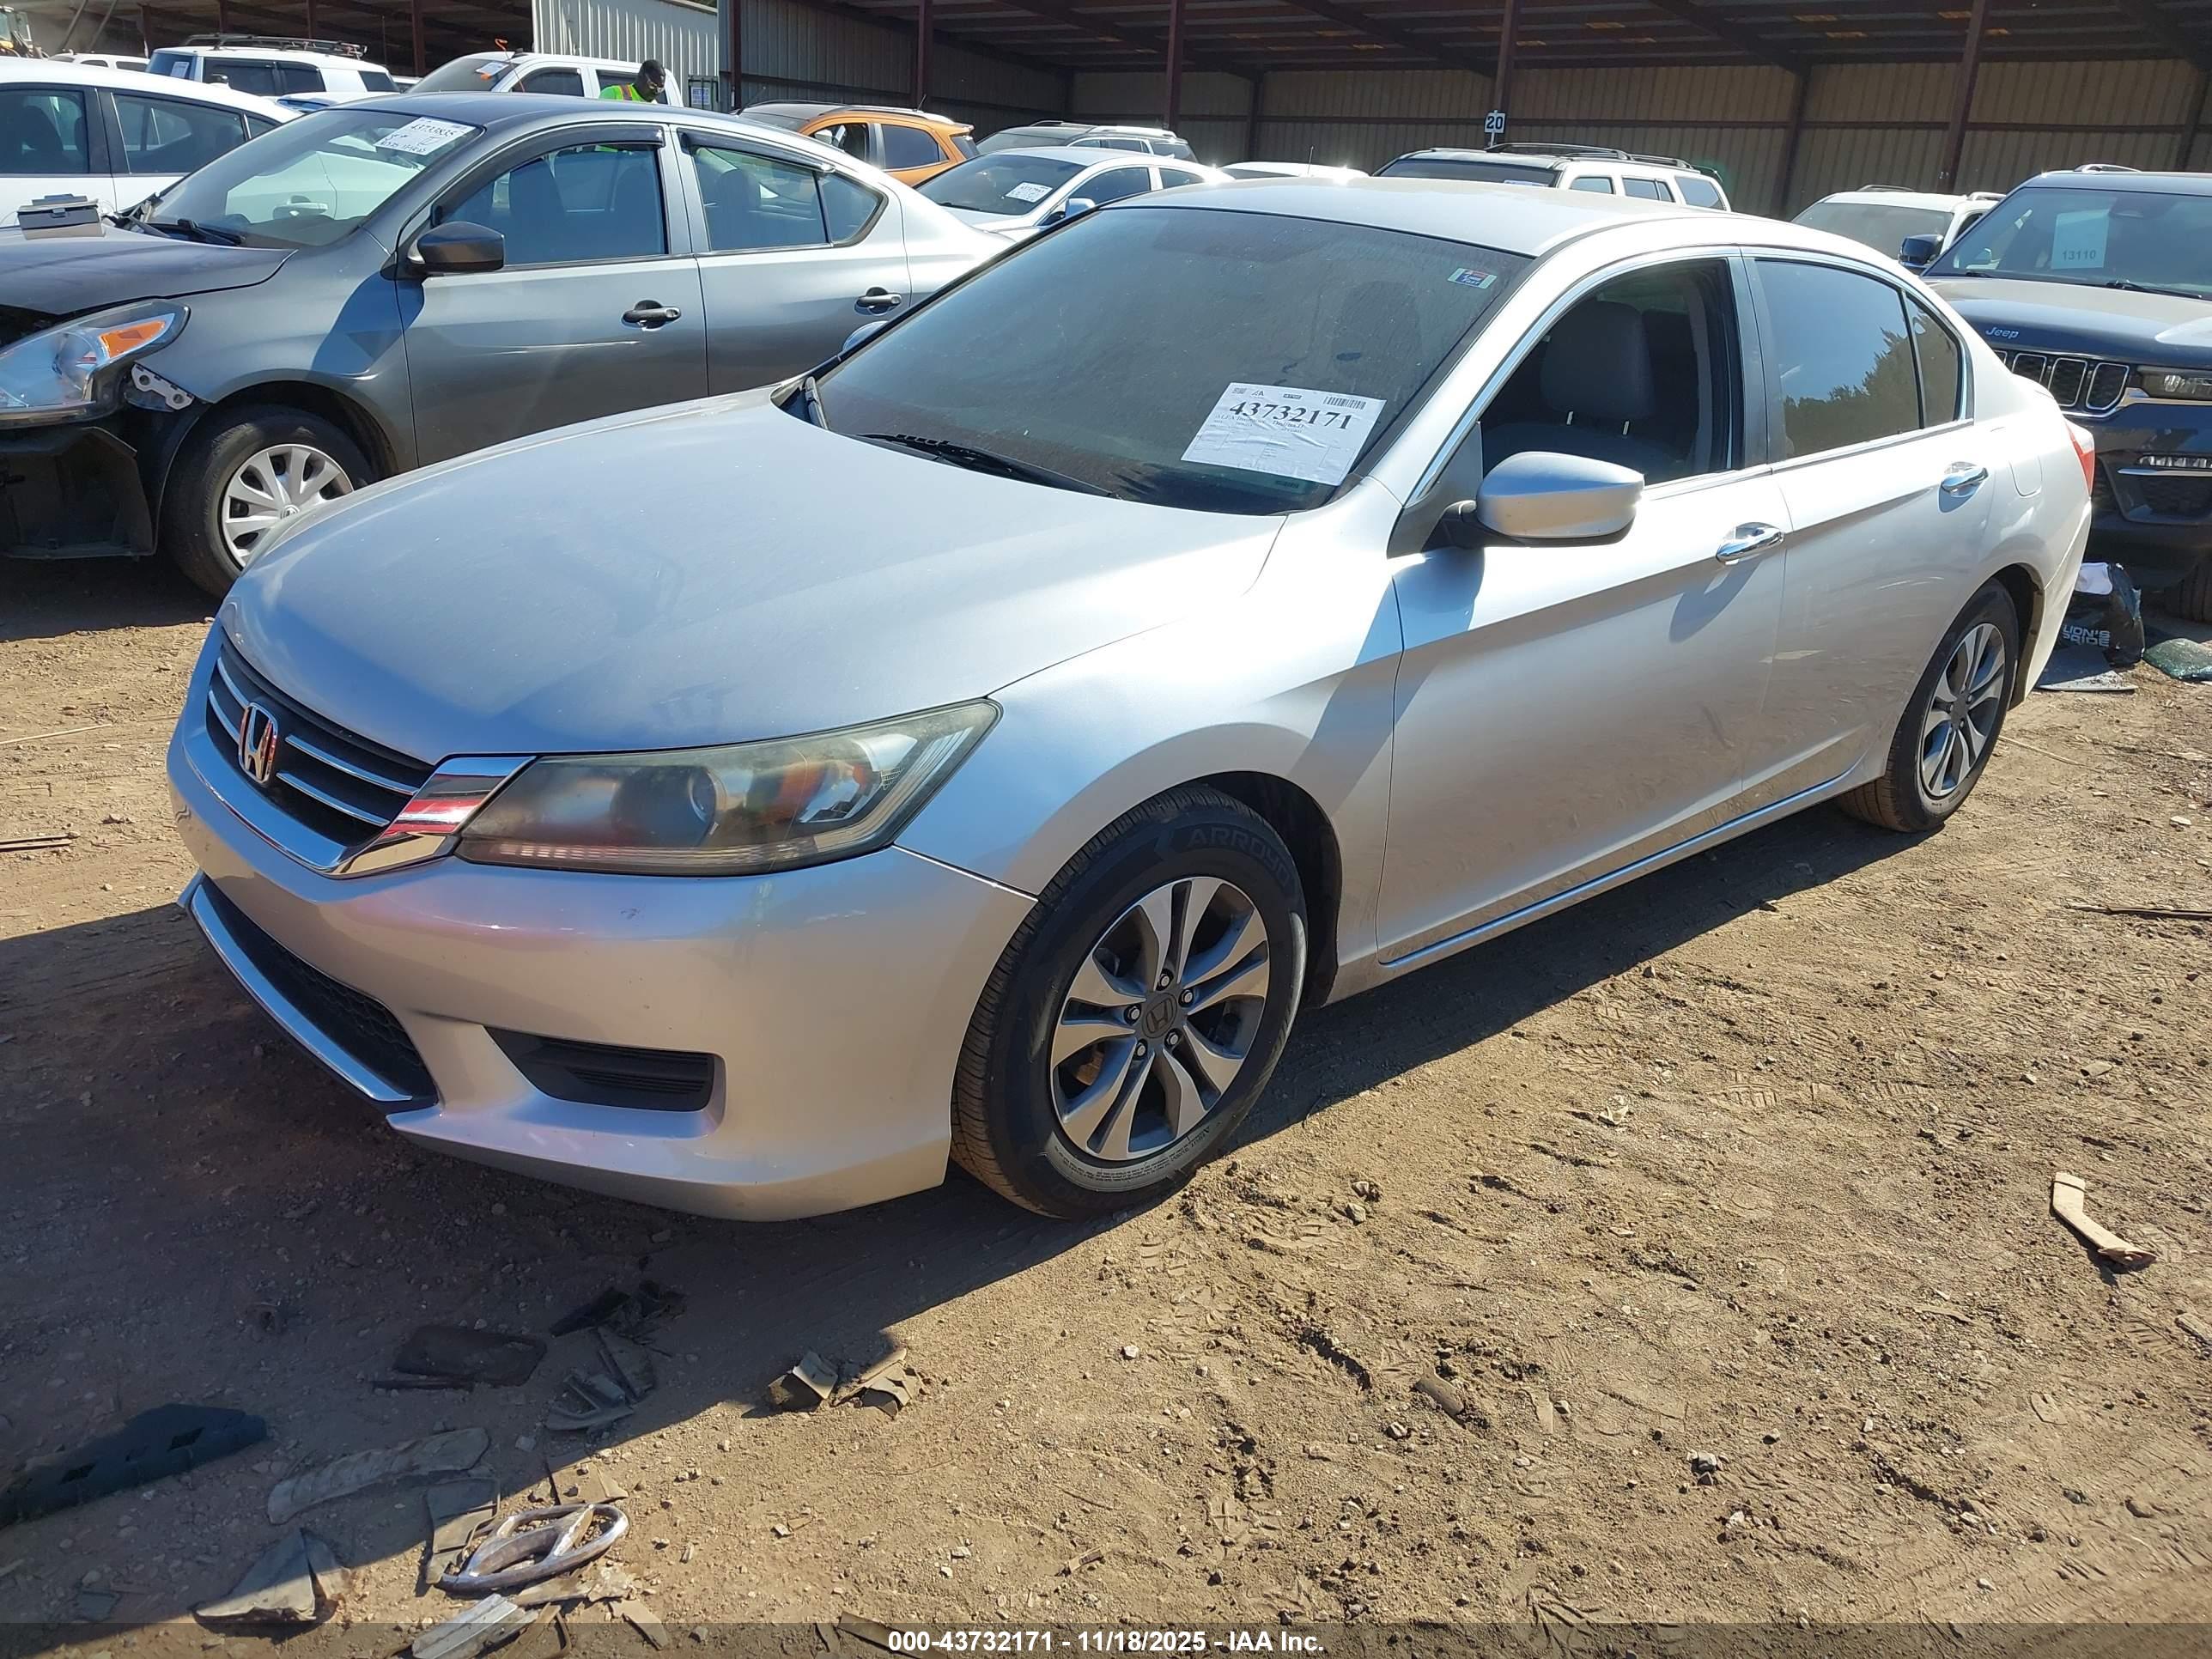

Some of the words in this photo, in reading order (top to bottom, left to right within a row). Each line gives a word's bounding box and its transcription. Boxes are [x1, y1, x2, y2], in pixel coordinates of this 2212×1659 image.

[1486, 116, 1504, 130] 20
[2062, 250, 2096, 261] 13110
[1985, 326, 2020, 339] Jeep
[1230, 401, 1354, 429] 43732171
[2063, 625, 2110, 638] LION'S
[1188, 826, 1292, 889] ARROYO
